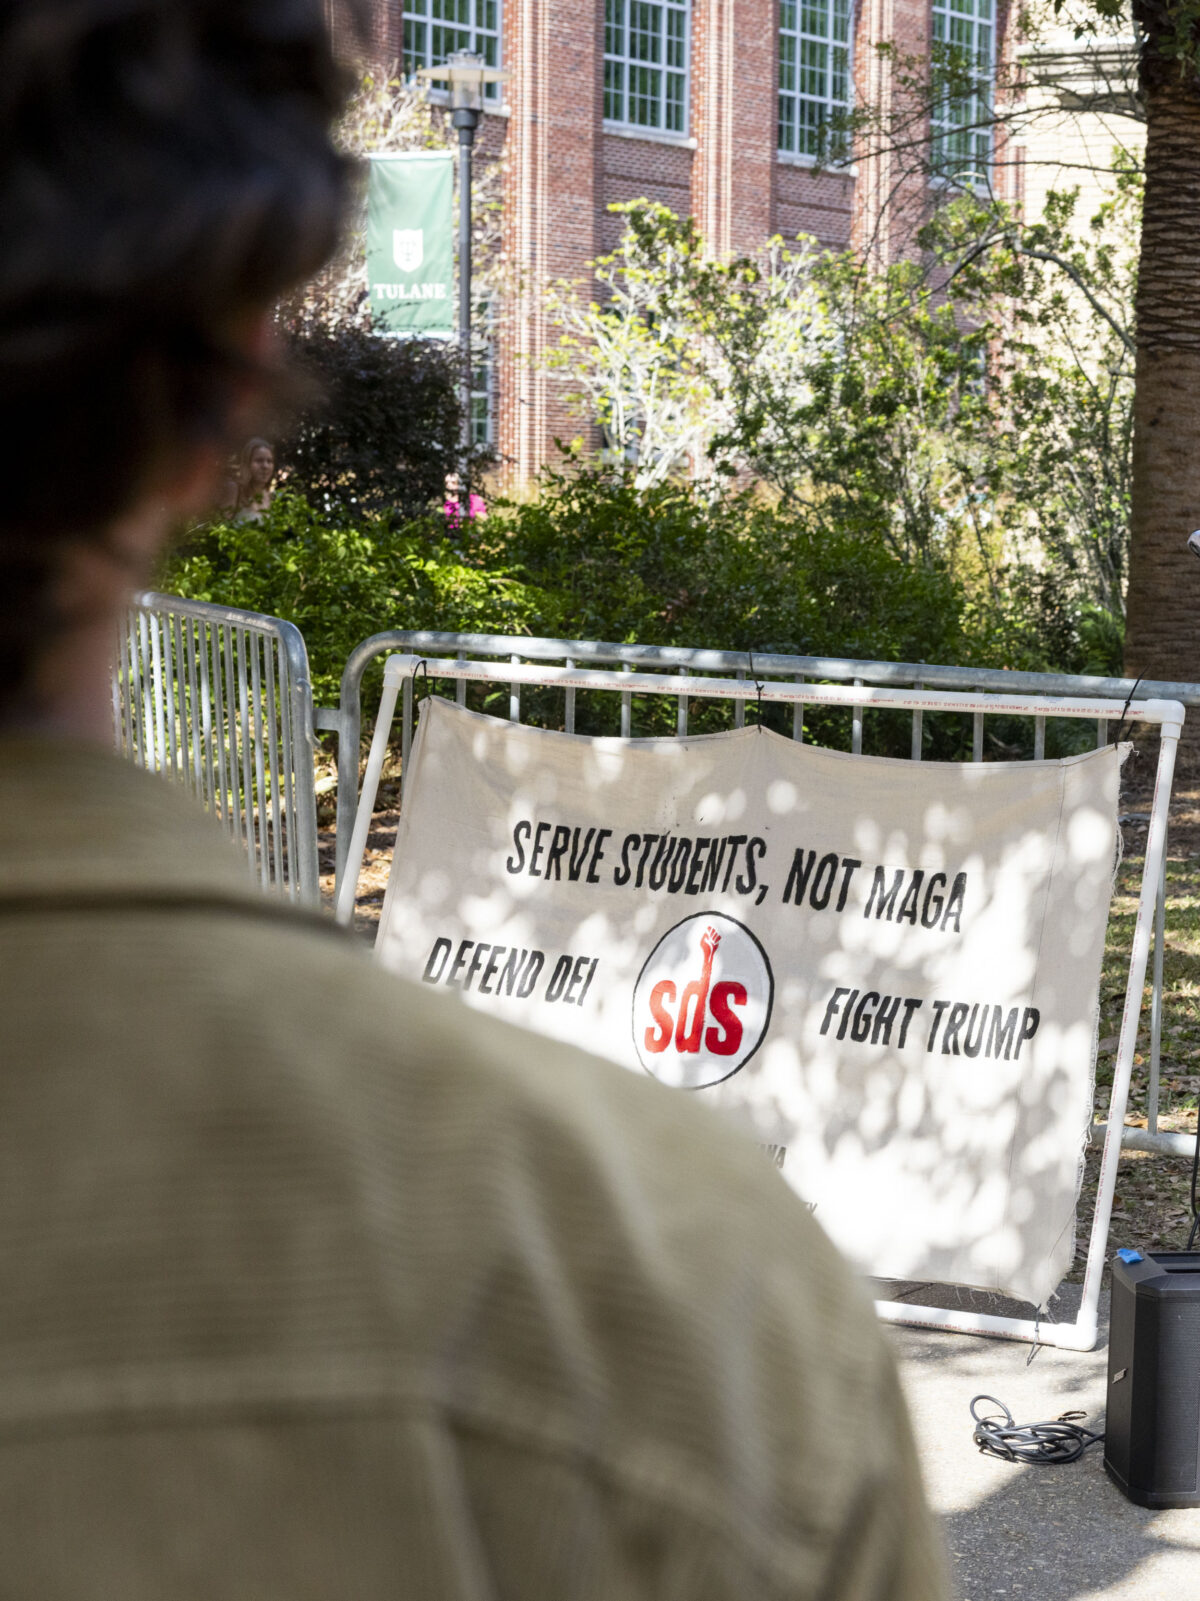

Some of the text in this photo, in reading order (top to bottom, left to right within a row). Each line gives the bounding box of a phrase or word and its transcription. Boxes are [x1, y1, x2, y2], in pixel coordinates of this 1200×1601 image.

[372, 283, 446, 299] TULANE
[506, 820, 967, 933] SERVE STUDENTS, NOT MAGA
[422, 937, 600, 1007] DEFEND DEI
[819, 987, 923, 1049] FIGHT
[927, 1000, 1040, 1061] TRUMP
